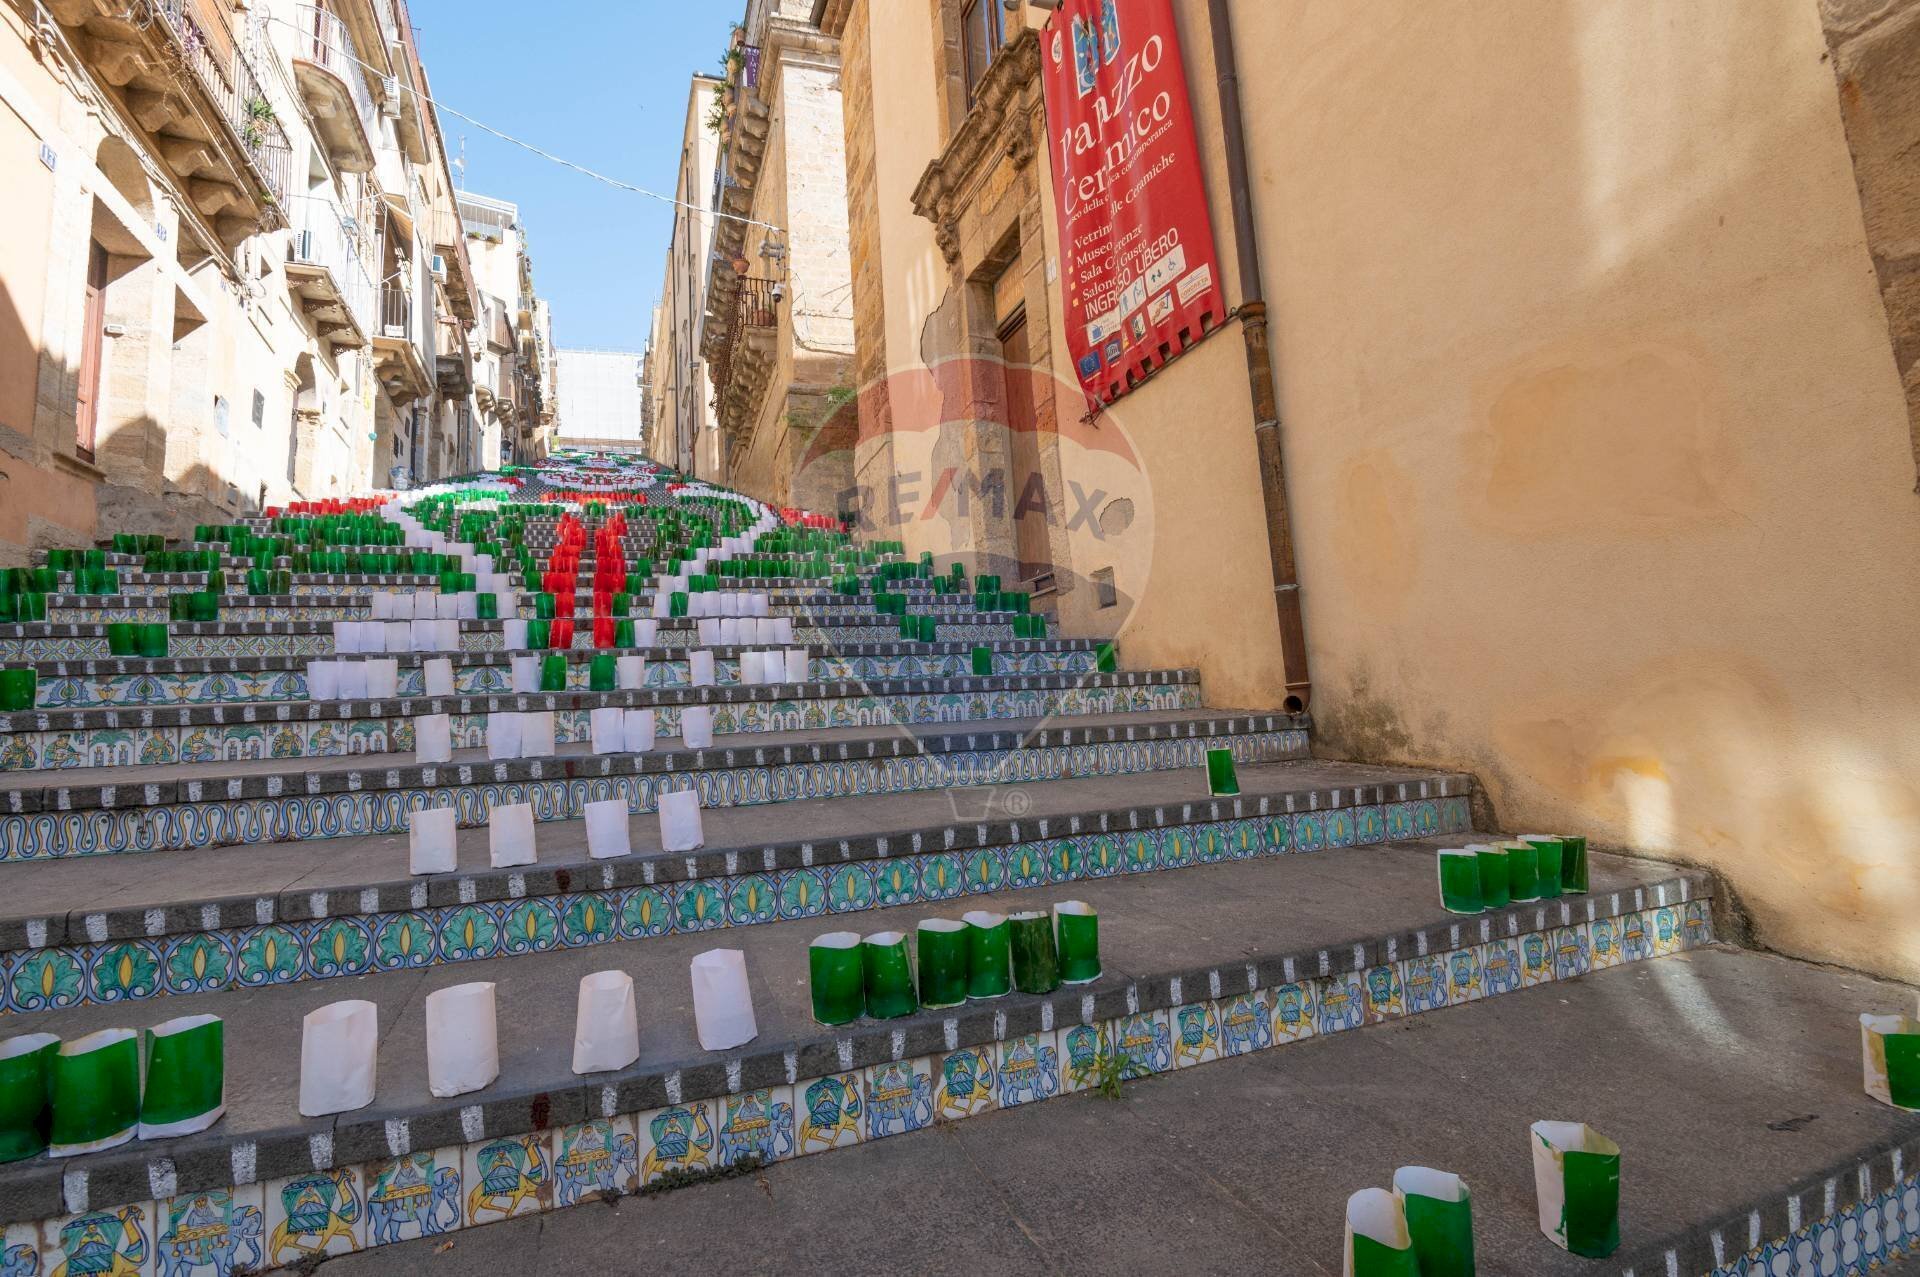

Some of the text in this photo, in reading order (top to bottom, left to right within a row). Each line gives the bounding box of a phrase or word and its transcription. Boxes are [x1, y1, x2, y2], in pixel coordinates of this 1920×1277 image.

[1125, 152, 1175, 204] Ceramiche
[1076, 242, 1114, 269] Museo
[1135, 227, 1178, 274] LIBERO
[1080, 264, 1103, 284] Sala
